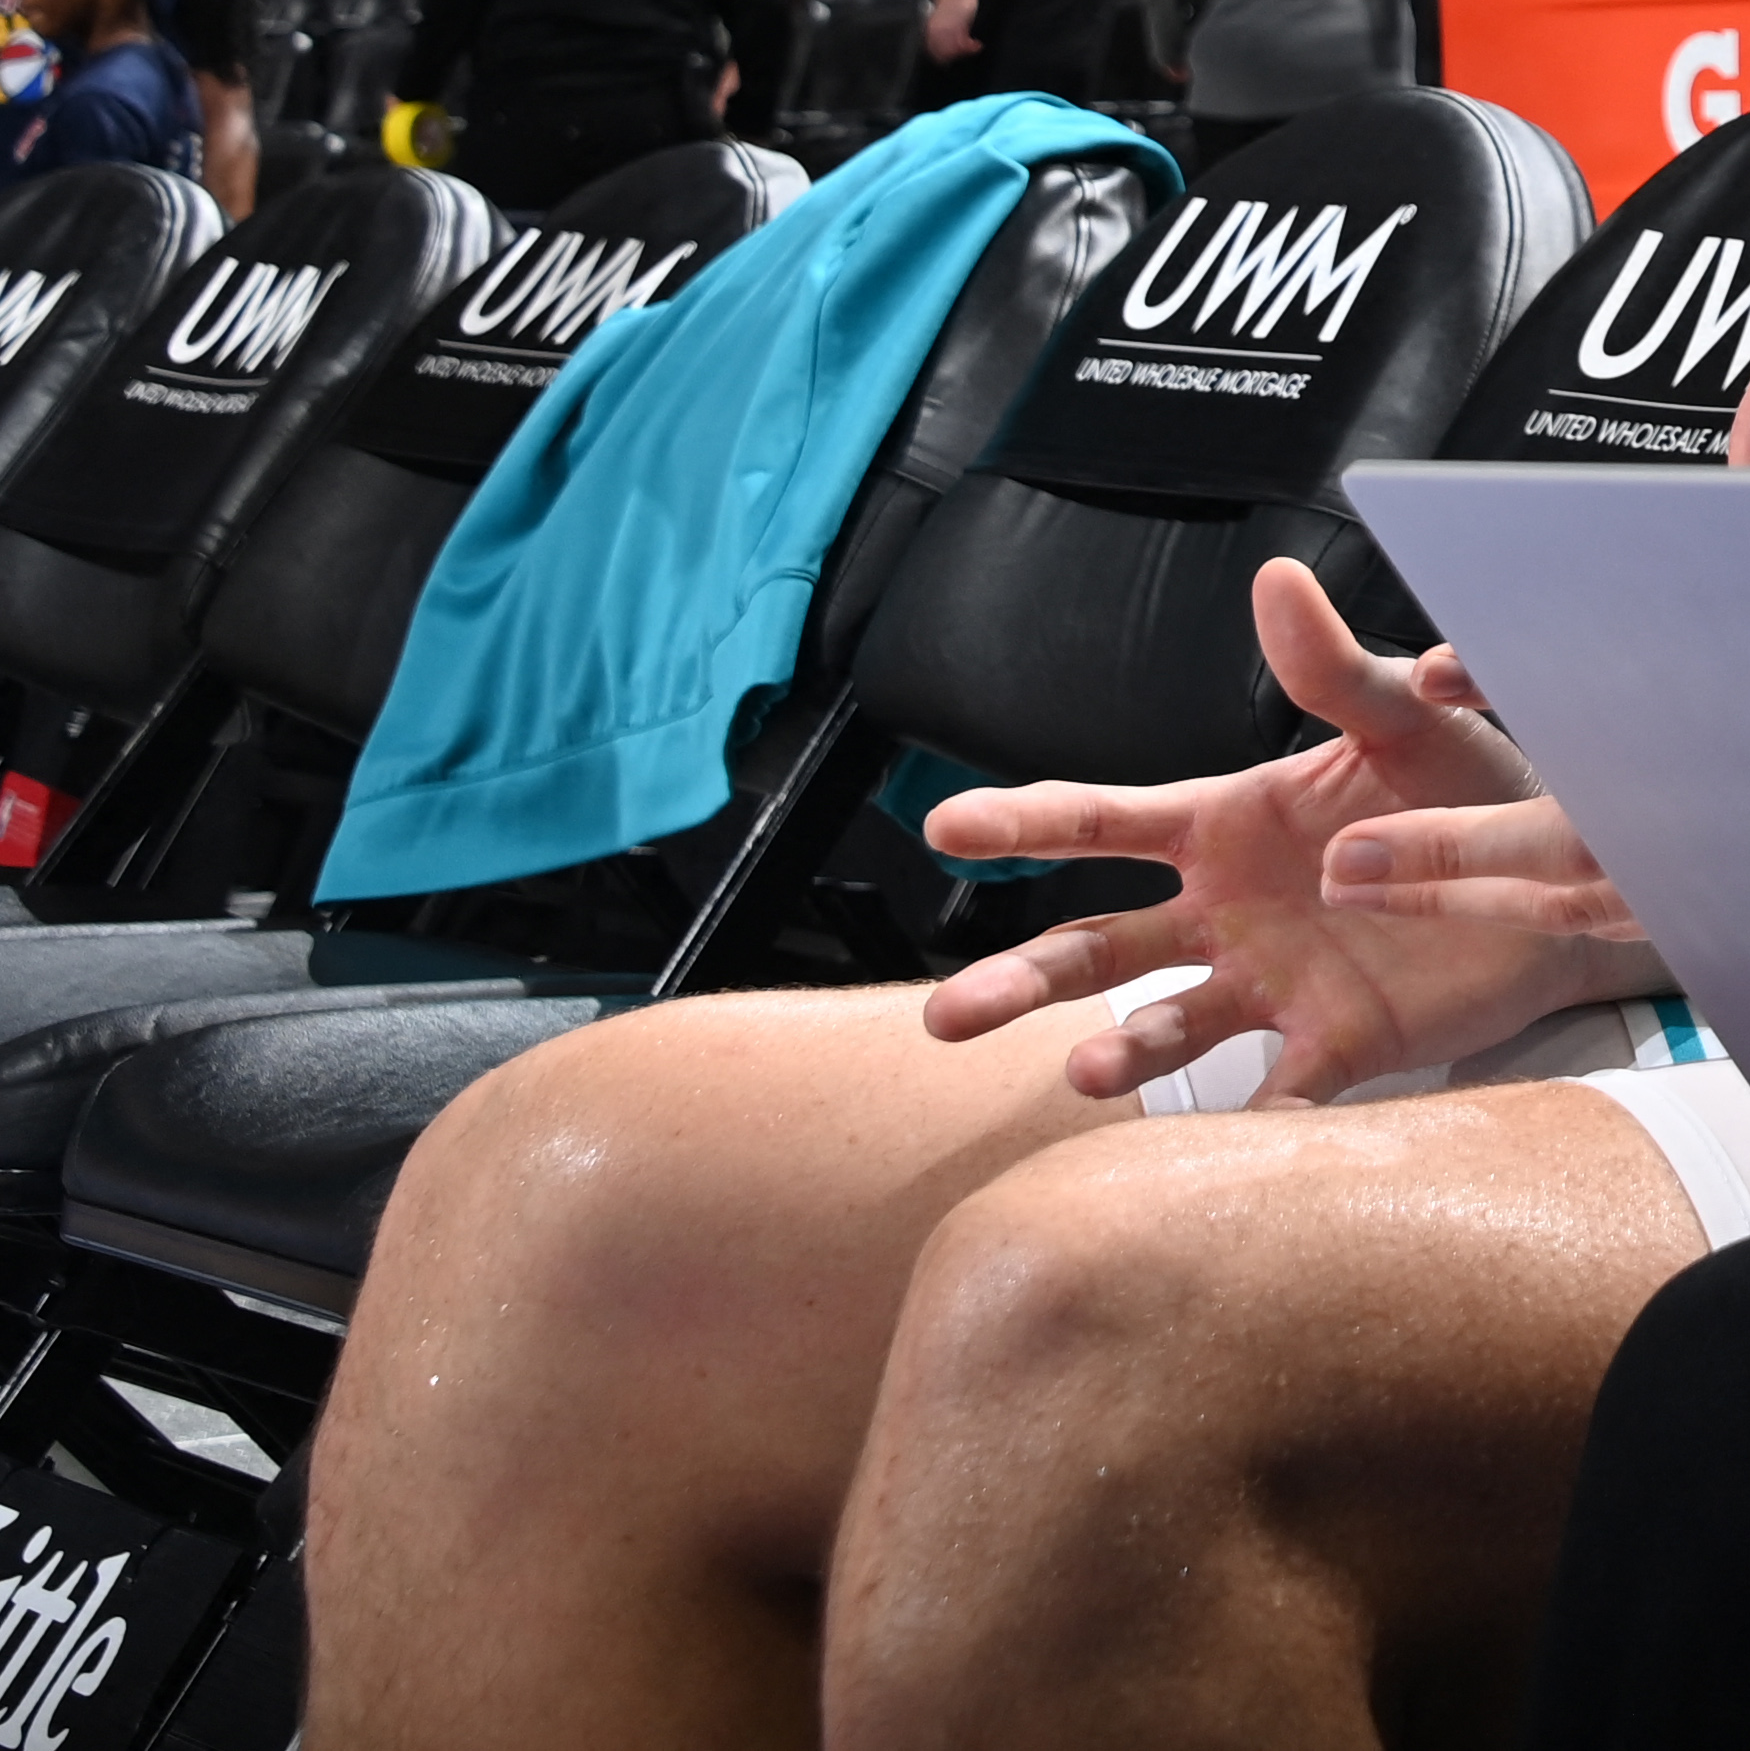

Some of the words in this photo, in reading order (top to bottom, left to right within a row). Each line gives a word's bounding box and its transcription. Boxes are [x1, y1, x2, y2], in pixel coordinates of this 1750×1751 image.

[167, 256, 349, 372] UWM
[460, 227, 697, 345] UWM
[1123, 197, 1408, 343] UWM
[1075, 357, 1134, 385] UNITED
[1129, 361, 1223, 392] WHOLESALE
[1214, 369, 1312, 400] MORTGAGE
[1524, 410, 1597, 441] UNITED
[1596, 418, 1712, 455] WHOLESALE
[0, 1504, 130, 1751] ittle
